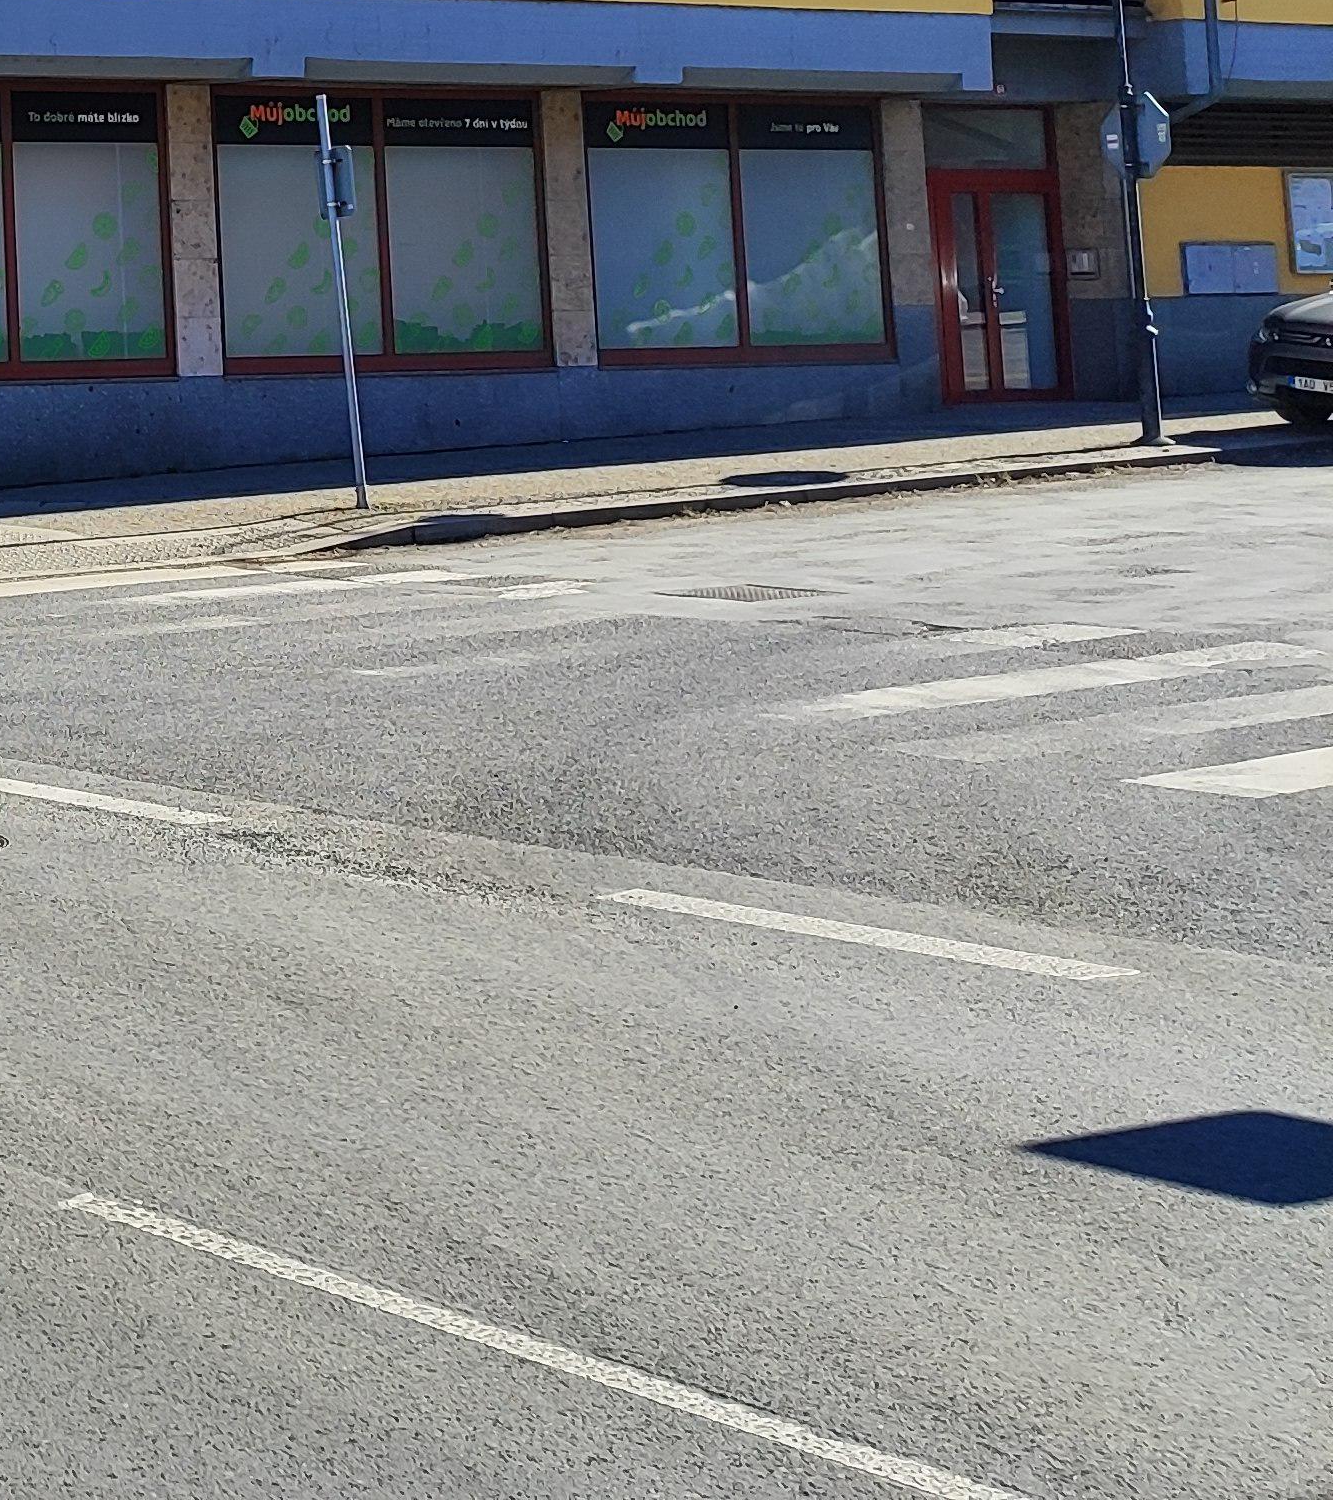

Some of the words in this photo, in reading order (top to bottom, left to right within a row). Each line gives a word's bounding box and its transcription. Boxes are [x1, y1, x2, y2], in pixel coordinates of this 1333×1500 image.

[28, 112, 41, 122] To
[250, 101, 350, 125] Můjobcod
[616, 107, 706, 130] Můjobchod
[464, 118, 471, 128] 7
